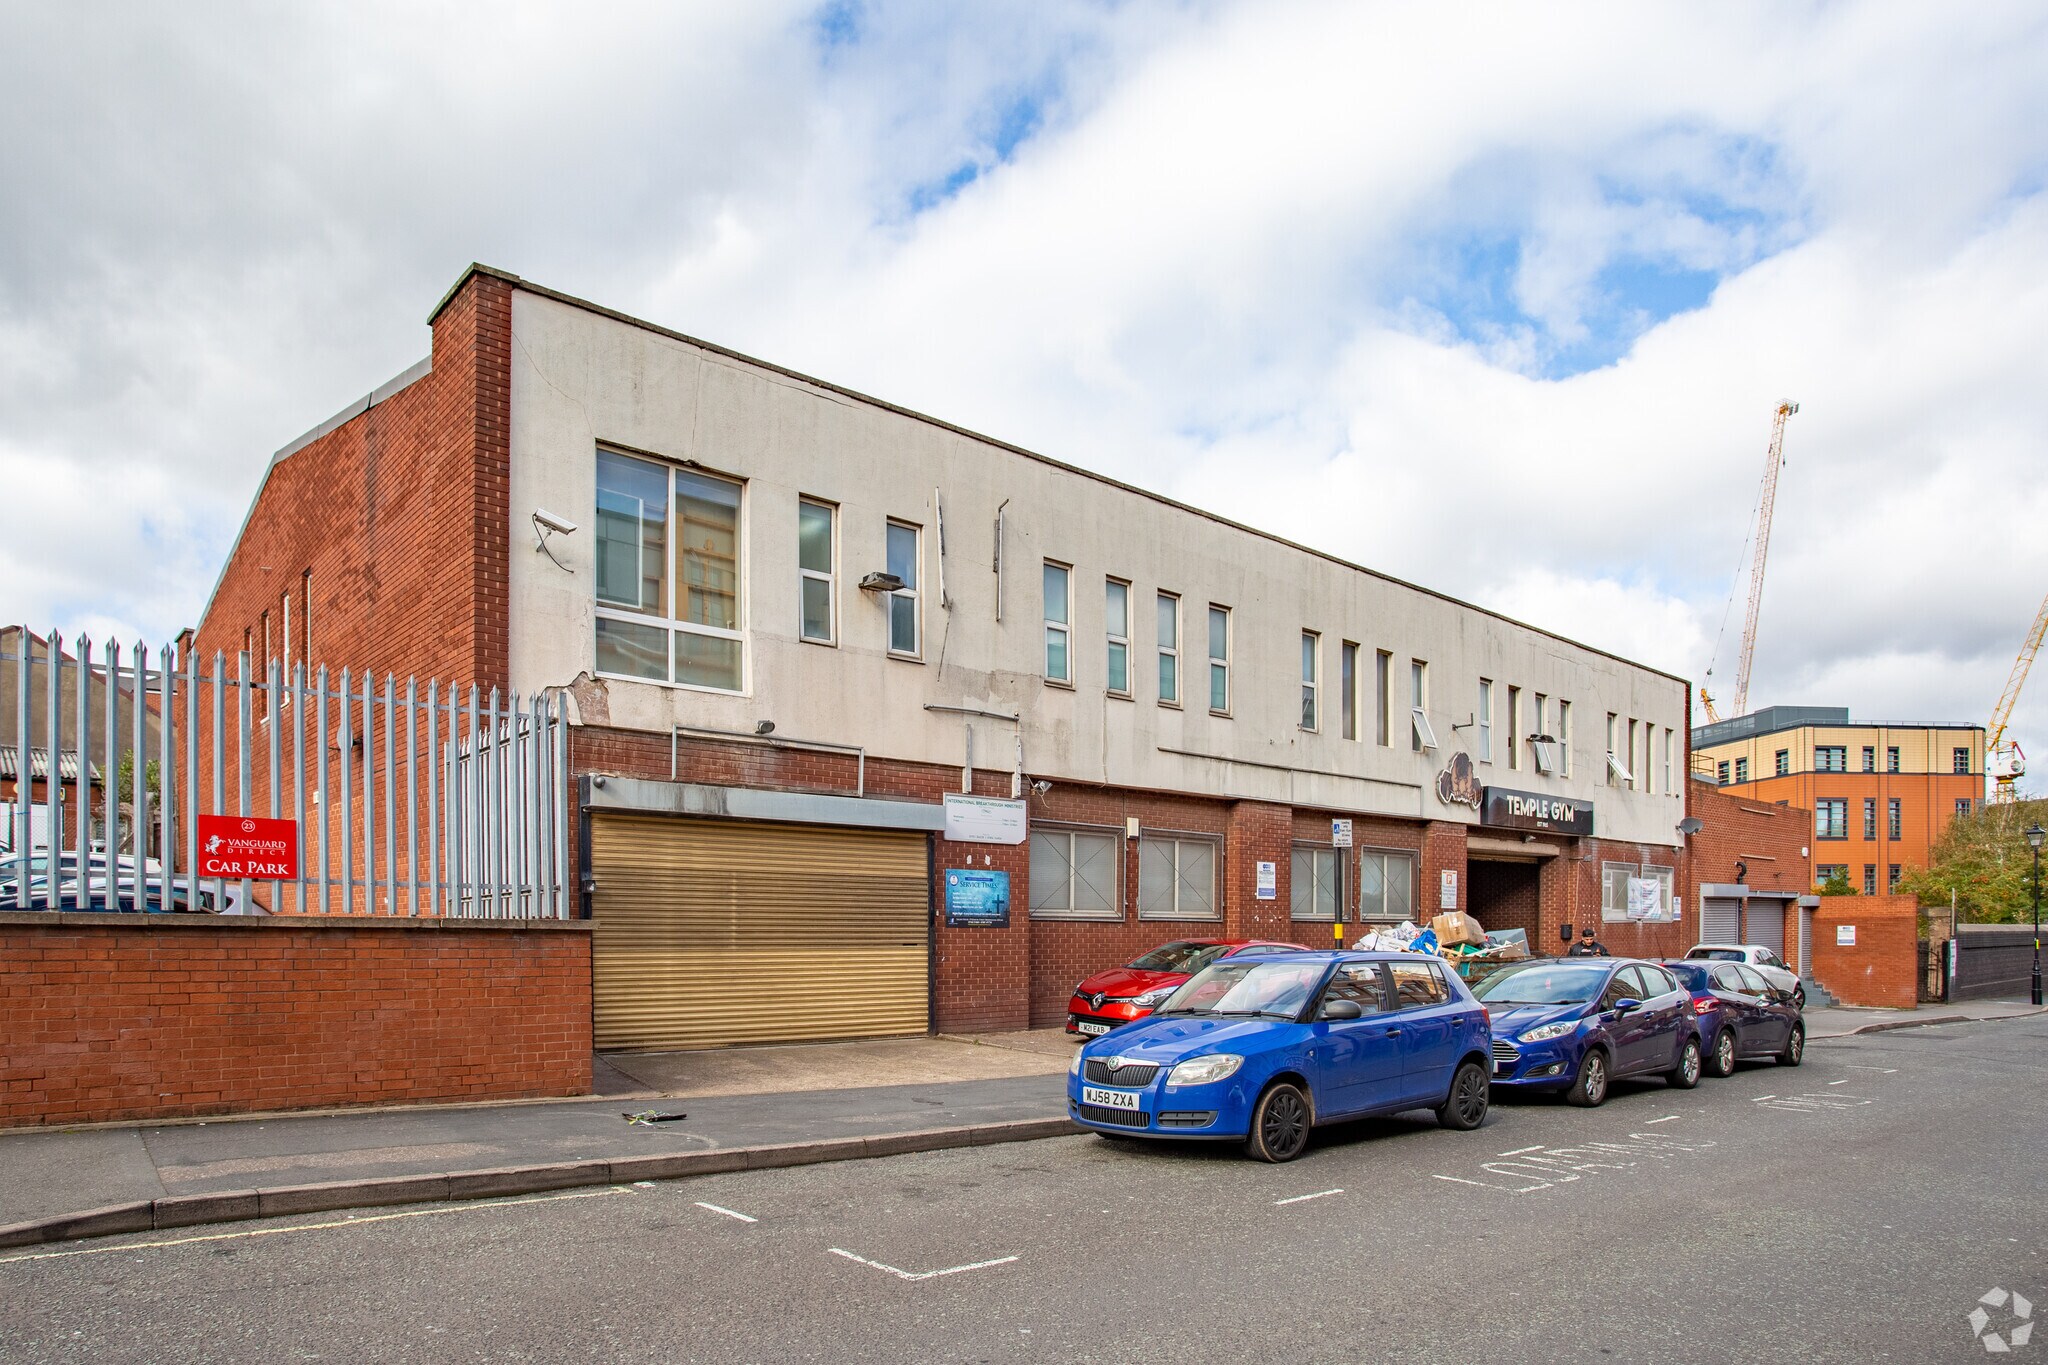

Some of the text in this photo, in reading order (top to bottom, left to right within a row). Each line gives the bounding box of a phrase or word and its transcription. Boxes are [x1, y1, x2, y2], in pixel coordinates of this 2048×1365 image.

[947, 798, 975, 806] INTERNATIONAL
[1506, 795, 1574, 822] TEMPLE GYM
[243, 822, 254, 830] 23
[227, 838, 287, 849] VANGUARD
[227, 848, 286, 856] DIRECT
[1093, 1025, 1105, 1034] EAB
[1112, 1093, 1134, 1108] ZXA
